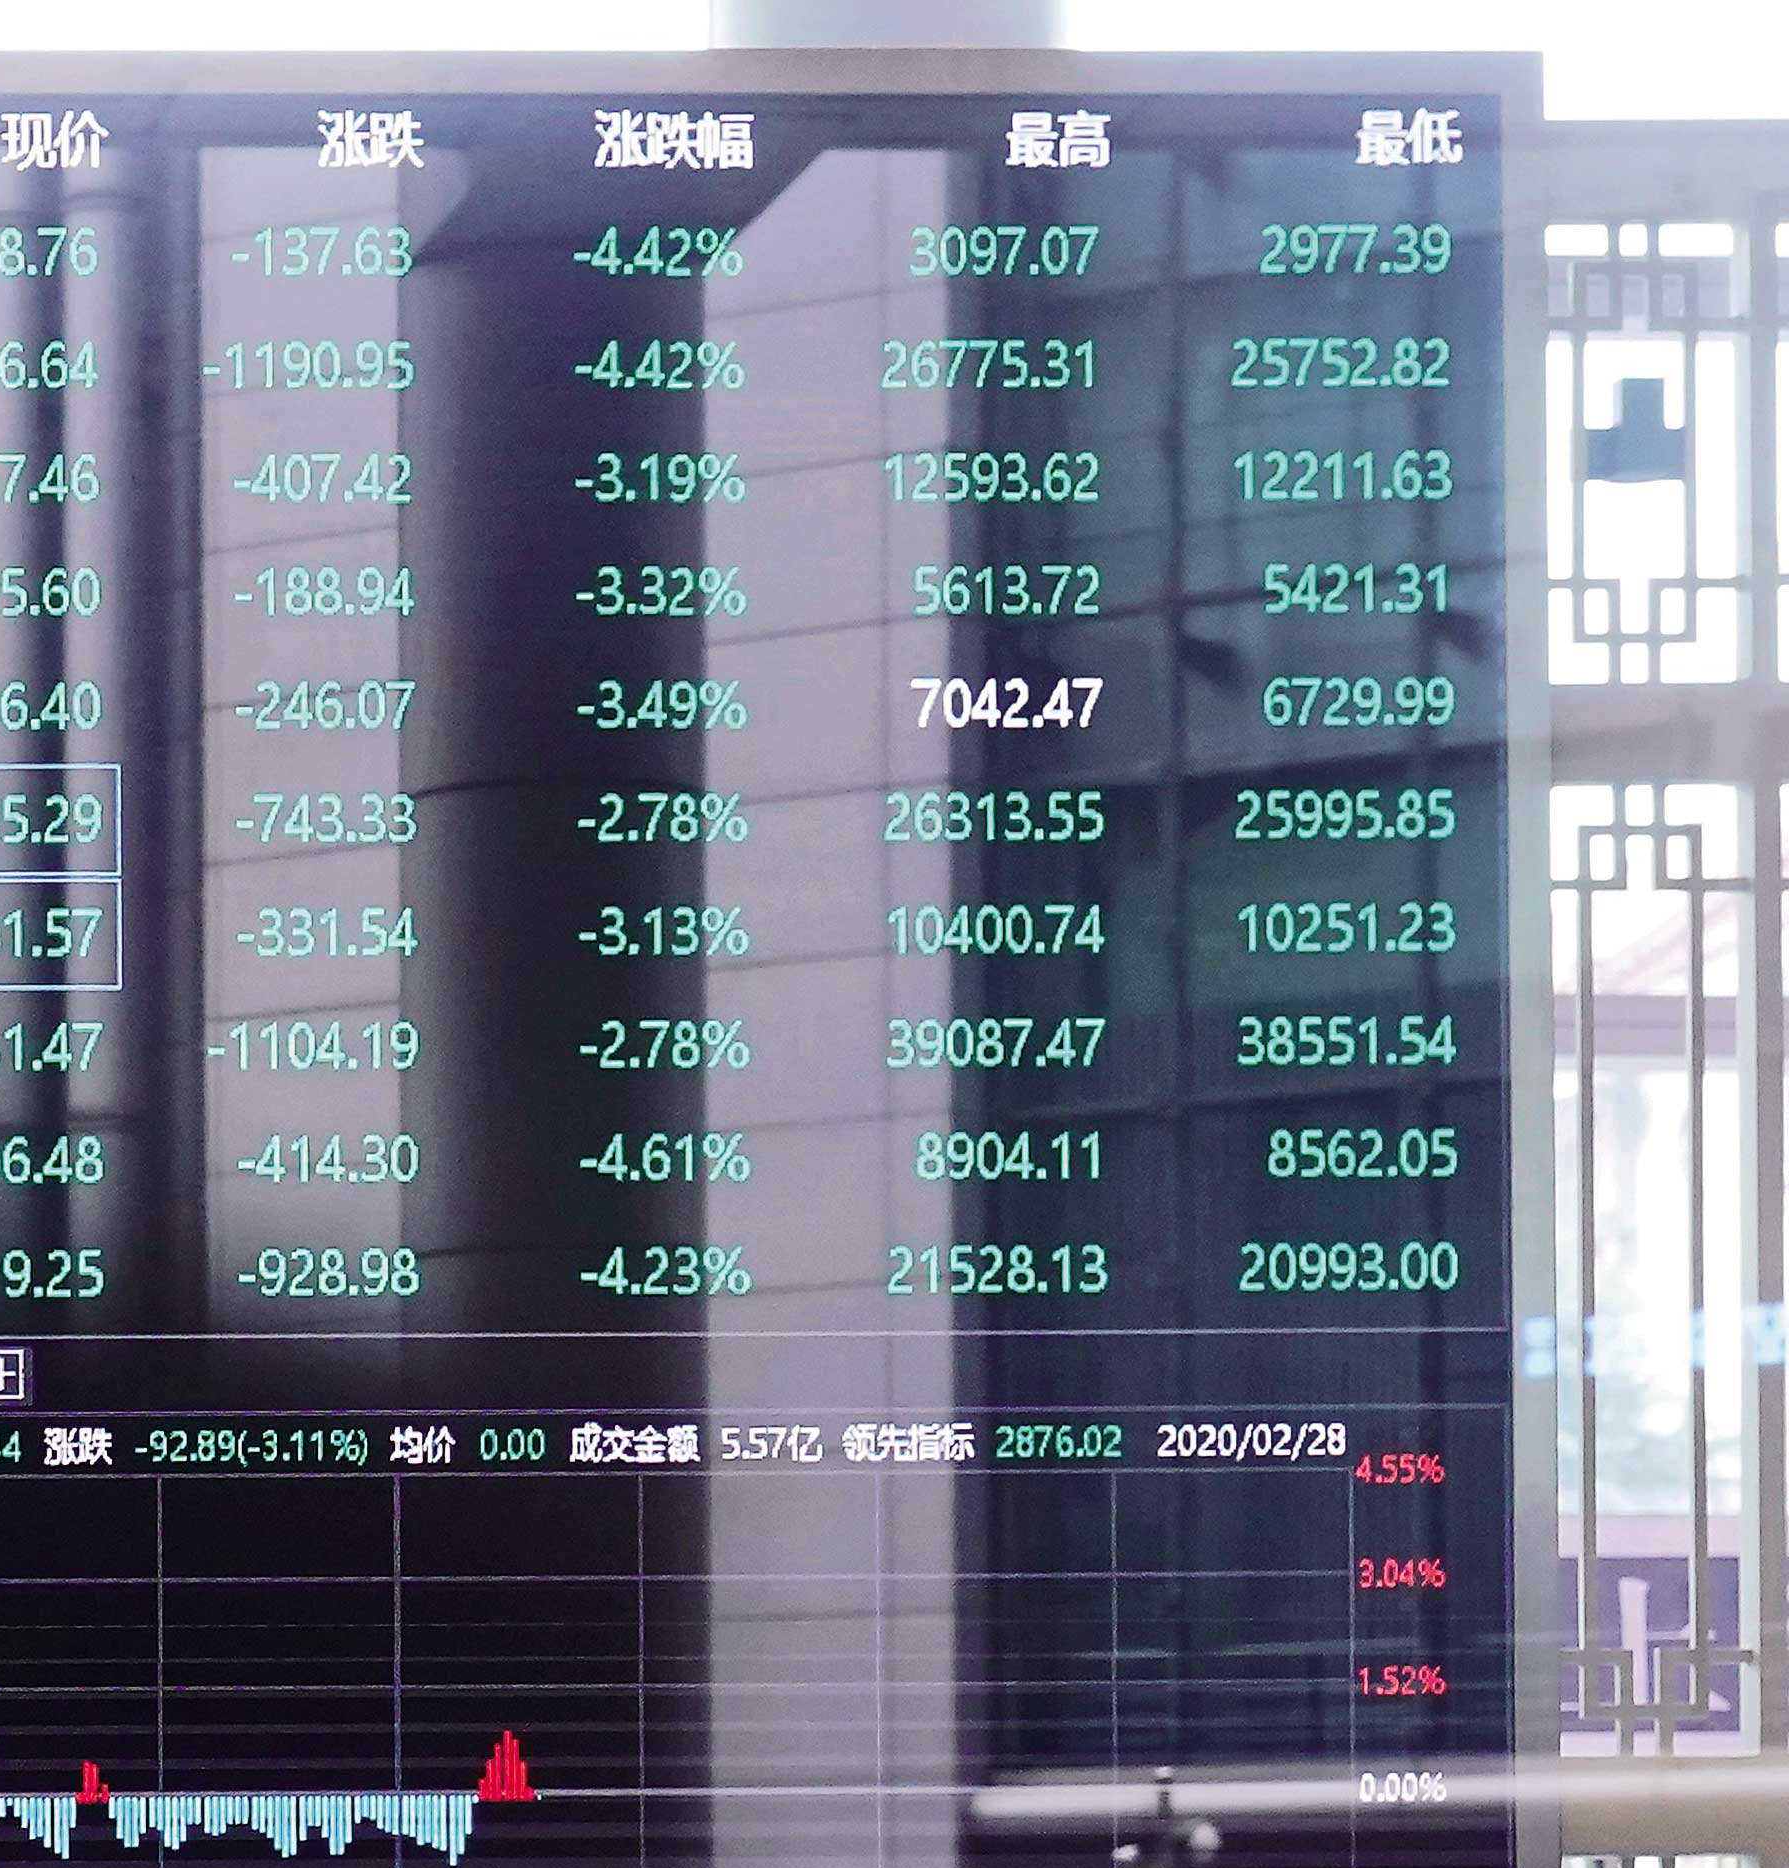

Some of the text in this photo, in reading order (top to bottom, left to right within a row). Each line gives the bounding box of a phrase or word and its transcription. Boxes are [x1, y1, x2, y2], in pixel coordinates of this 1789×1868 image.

[1, 110, 109, 171] 现价
[318, 110, 424, 168] 涨跌
[594, 109, 754, 169] 涨跌幅
[1005, 110, 1111, 168] 最高
[1355, 108, 1463, 166] 最低
[203, 341, 414, 389] -1190.95
[575, 340, 743, 389] -4.42%
[883, 340, 1092, 388] 26775.31
[1231, 337, 1450, 387] 25752.82
[234, 454, 413, 504] -407.42
[575, 453, 744, 503] -3.19%
[885, 452, 1098, 501] 12593.62
[1235, 449, 1452, 500] 12211.63
[236, 680, 415, 729] -246.07
[577, 680, 746, 729] -3.49%
[911, 678, 1103, 728] 7042.47
[1264, 677, 1454, 726] 6729.99
[237, 907, 418, 958] -331.54
[579, 906, 747, 955] -3.13%
[889, 905, 1105, 954] 10400.74
[1238, 902, 1455, 952] 10251.23
[208, 1021, 418, 1069] -1104.19
[580, 1020, 748, 1068] -2.78%
[888, 1018, 1105, 1067] 39087.47
[1238, 1015, 1456, 1065] 38551.54
[239, 1248, 419, 1296] -928.98
[581, 1246, 750, 1295] -4.23%
[889, 1245, 1108, 1293] 21528.13
[1240, 1242, 1458, 1291] 20993.00
[44, 1428, 112, 1466] 涨跌
[390, 1426, 455, 1464] 均价
[481, 1429, 545, 1460] 0.00
[570, 1422, 700, 1463] 成交金额
[721, 1425, 822, 1462] 5.57亿
[842, 1423, 975, 1462] 领先指标
[996, 1425, 1121, 1457] 2876.02
[1157, 1423, 1346, 1461] 2020/02/28
[1355, 1454, 1444, 1483] 4.55%
[1359, 1558, 1445, 1588] 3.04%
[1359, 1665, 1446, 1695] 1.52%
[1356, 1772, 1450, 1802] 0.00%
